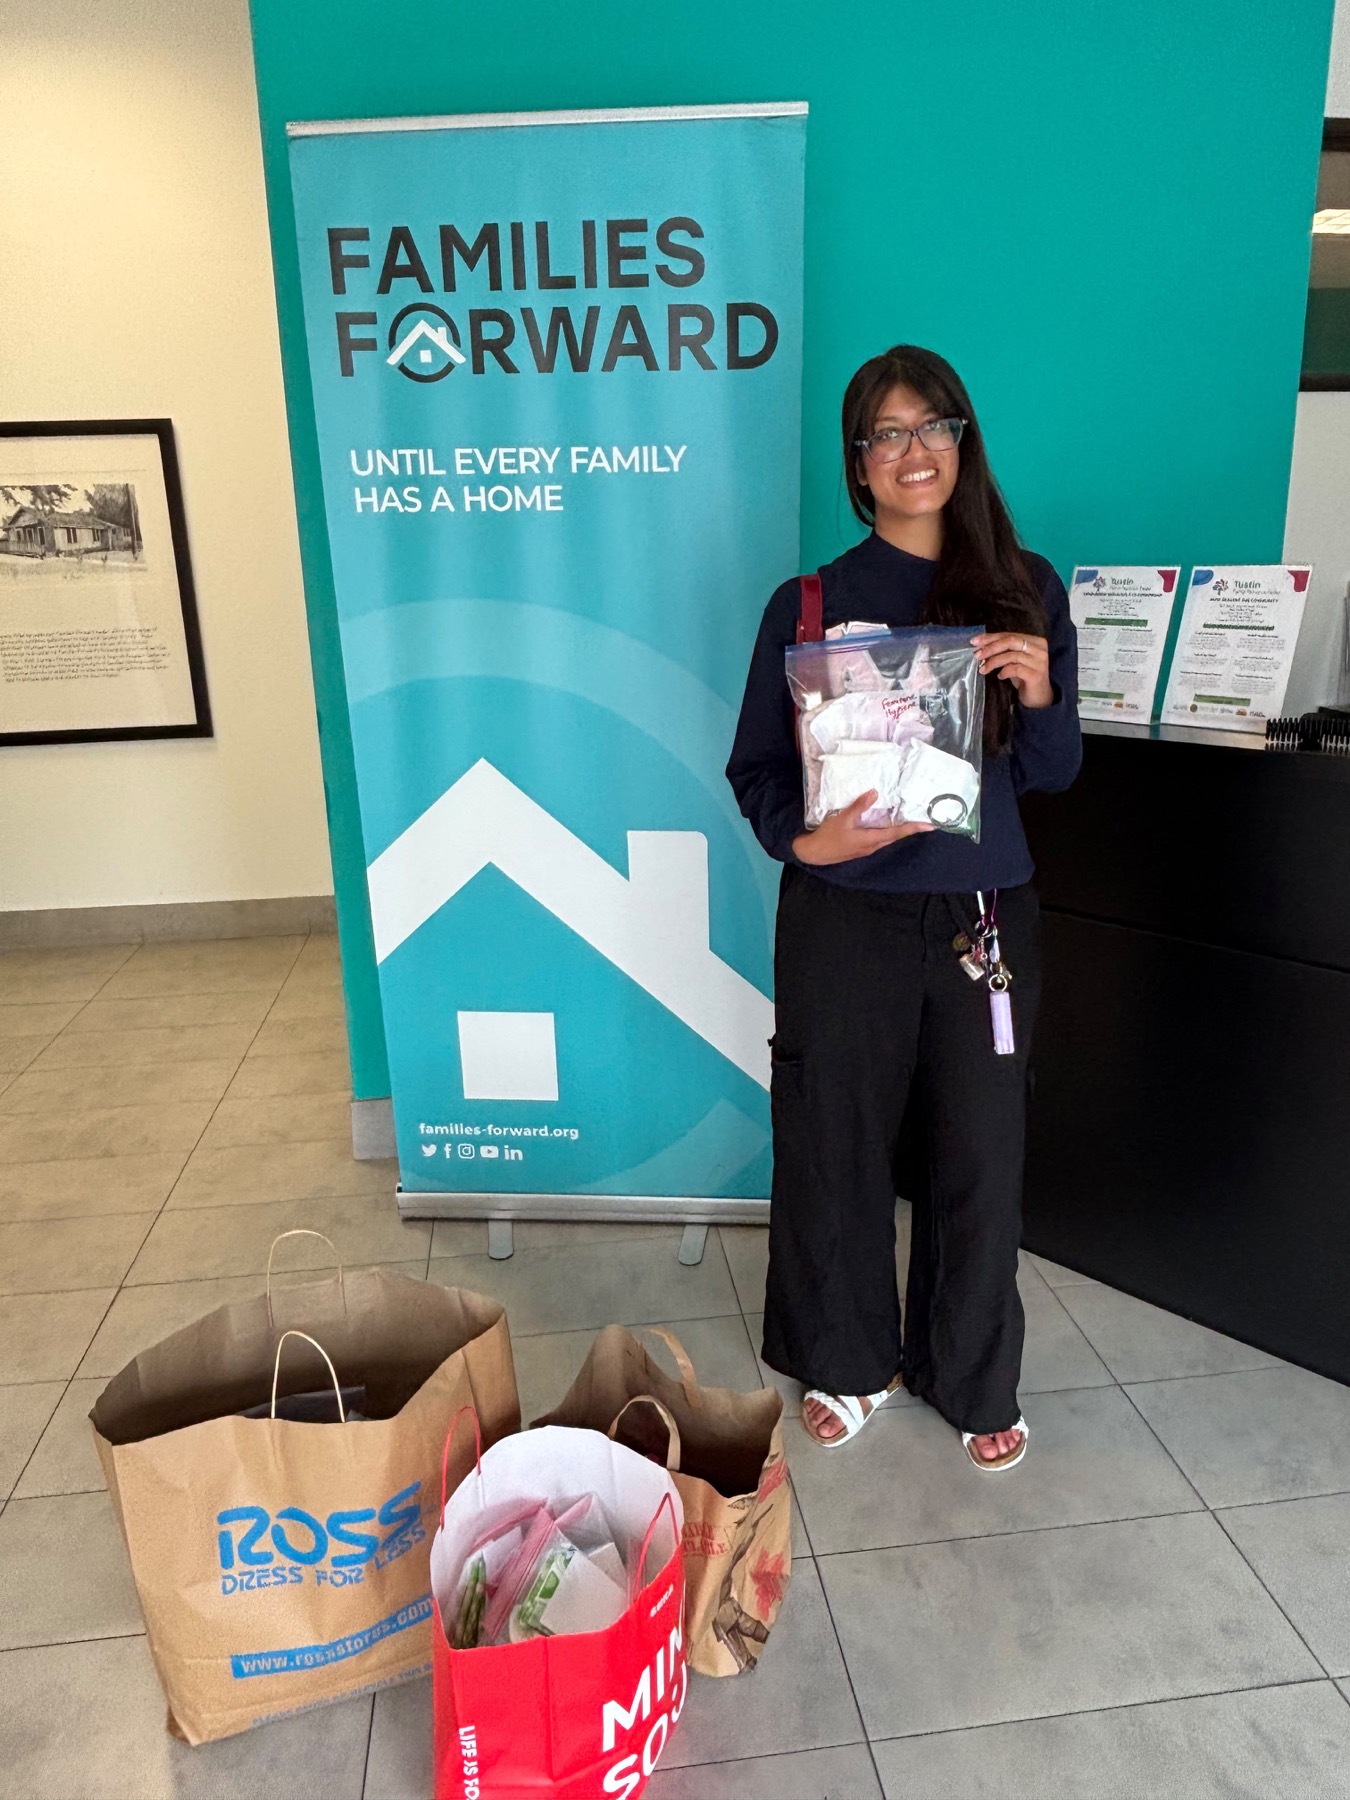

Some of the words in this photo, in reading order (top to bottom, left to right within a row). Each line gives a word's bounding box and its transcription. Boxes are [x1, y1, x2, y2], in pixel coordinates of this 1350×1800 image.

[327, 216, 706, 294] FAMILIES
[335, 302, 779, 383] FORWARD
[350, 448, 446, 476] UNTIL
[454, 446, 561, 475] EVERY
[570, 445, 687, 473] FAMILY
[354, 486, 422, 513] HAS
[430, 486, 455, 512] A
[463, 485, 564, 512] HOME
[419, 1123, 579, 1140] families-forward.org
[217, 1481, 421, 1570] ROSS
[221, 1566, 303, 1595] DRESS
[315, 1567, 364, 1588] FOR
[374, 1521, 426, 1570] LESS
[459, 1725, 478, 1758] LIFE
[463, 1759, 479, 1776] IS
[463, 1778, 480, 1800] FO
